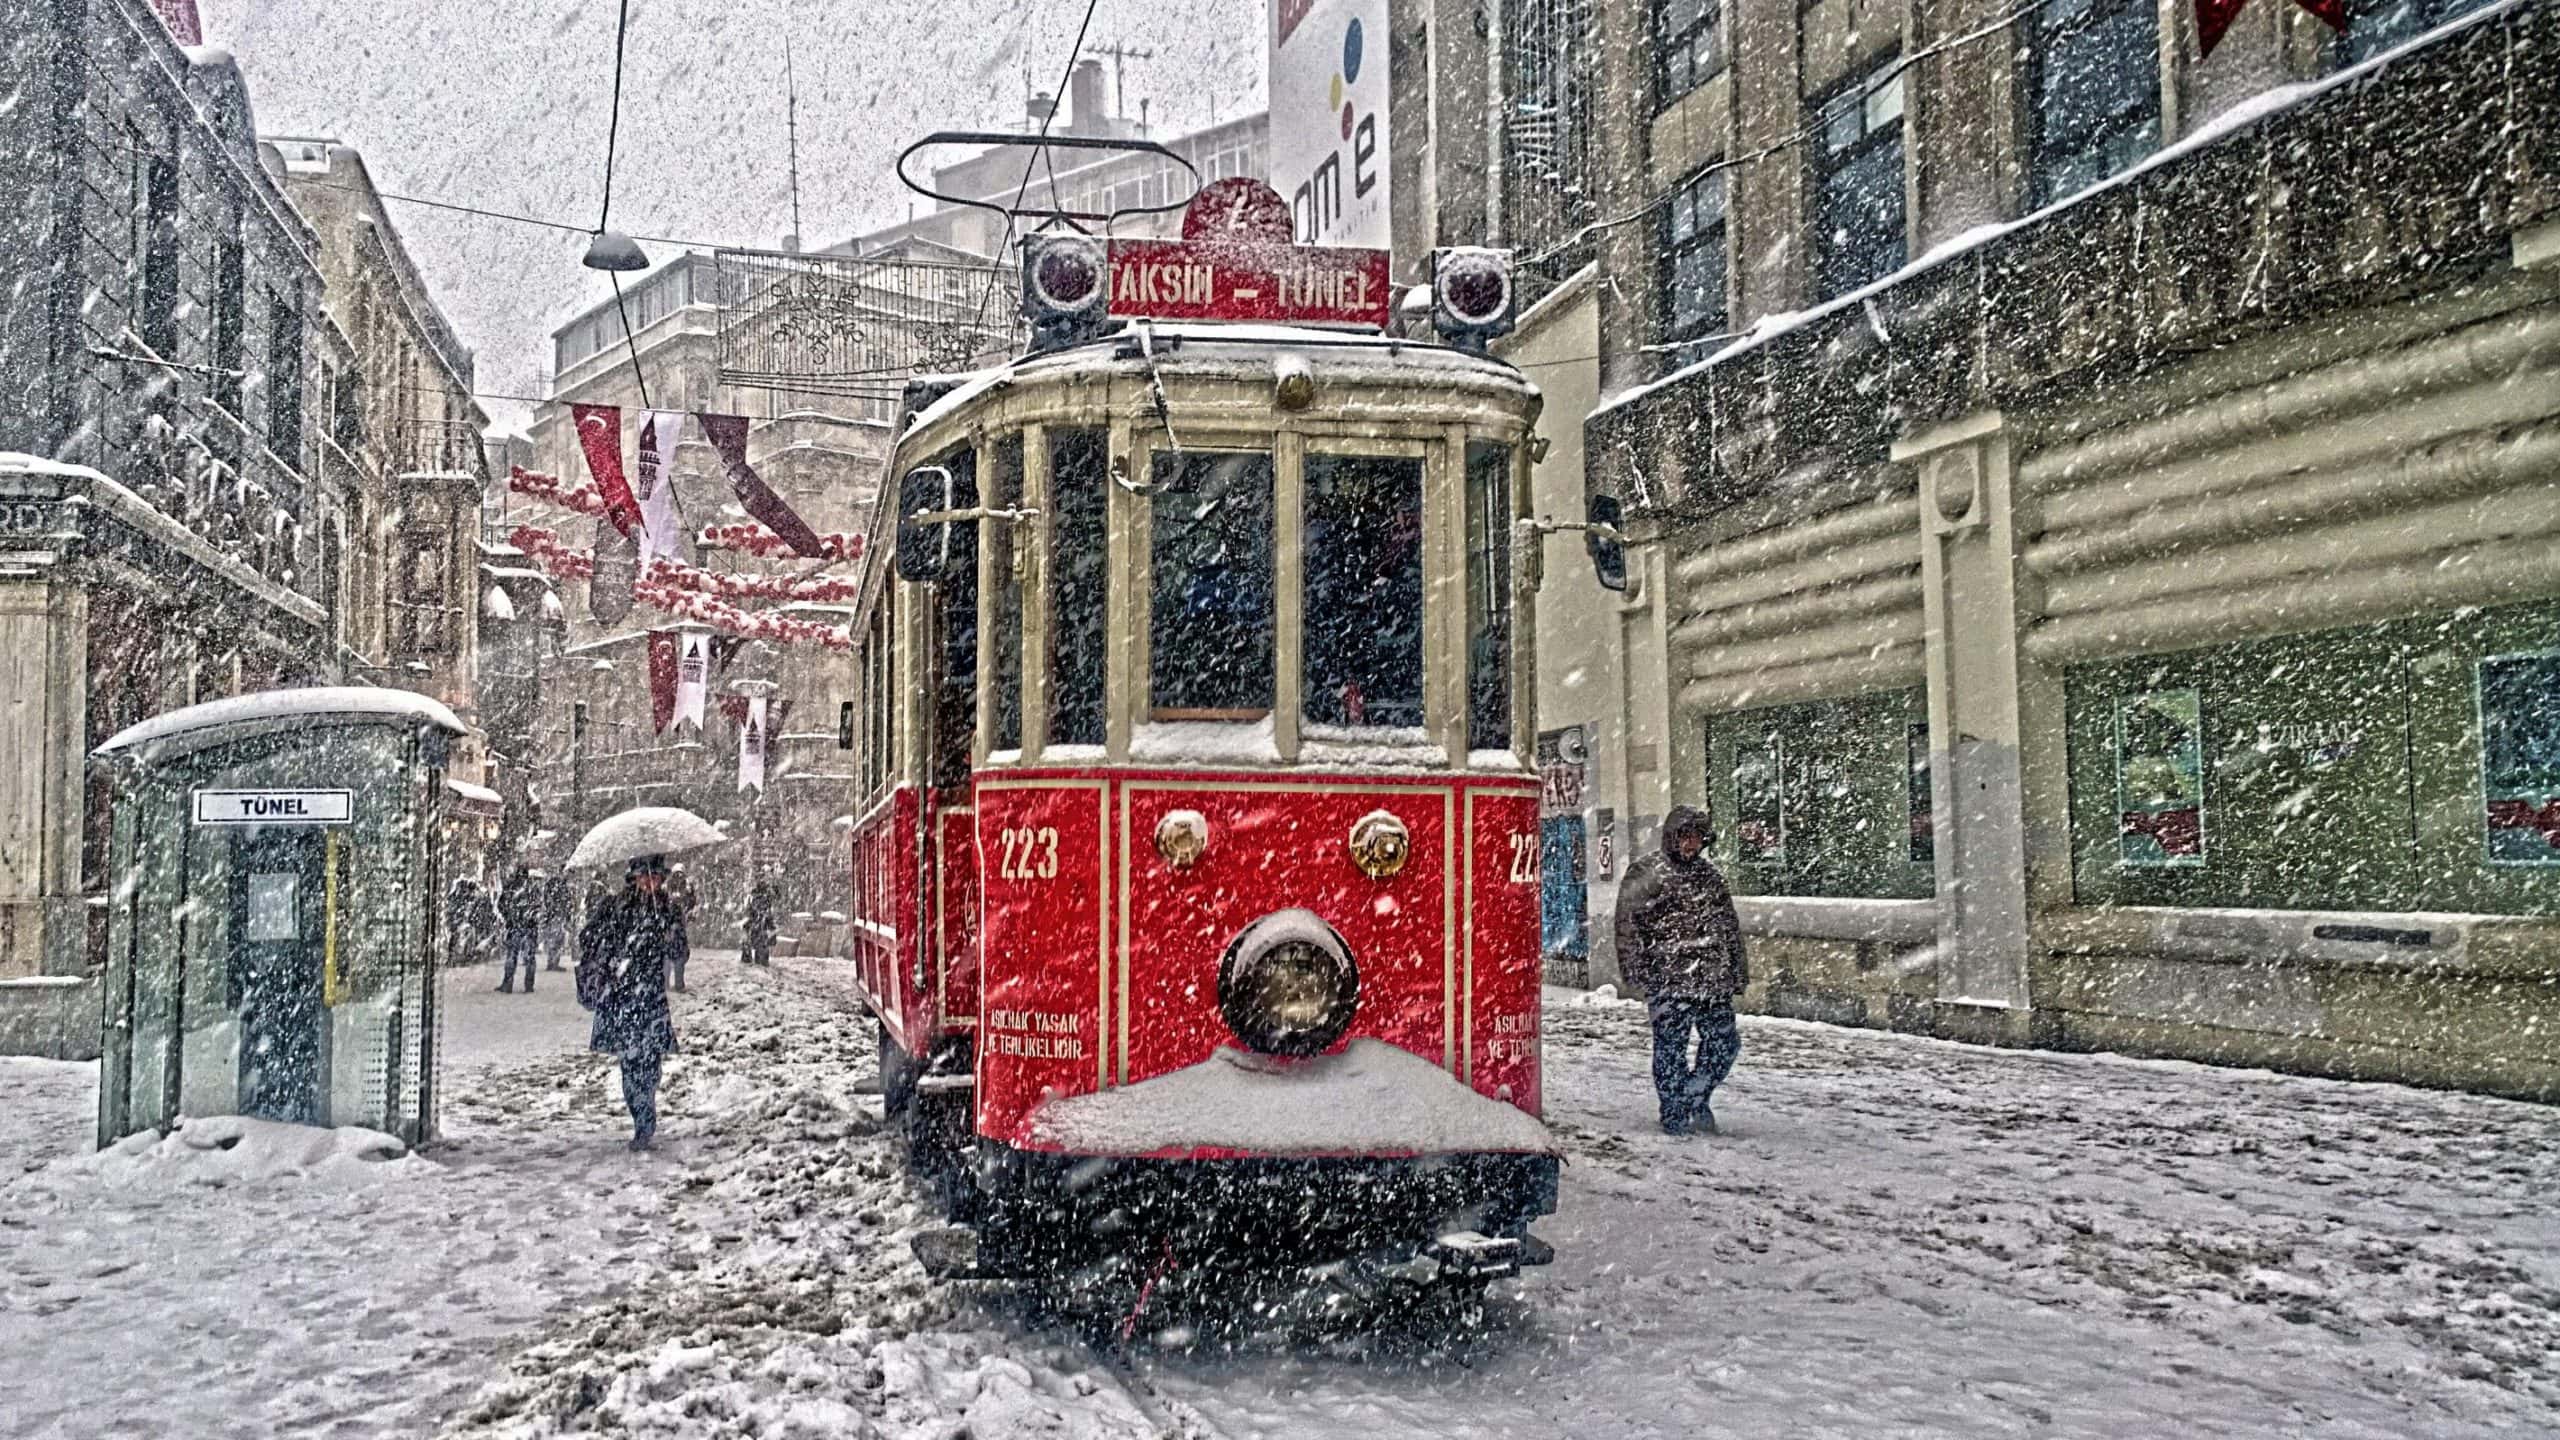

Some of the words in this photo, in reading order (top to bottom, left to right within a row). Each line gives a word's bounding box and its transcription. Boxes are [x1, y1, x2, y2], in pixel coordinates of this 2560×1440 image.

[1108, 256, 1214, 305] TAKSİM
[240, 796, 309, 816] TÜNEL
[1001, 826, 1059, 879] 223
[1035, 1011, 1079, 1034] YASAK
[1488, 1038, 1504, 1060] VE
